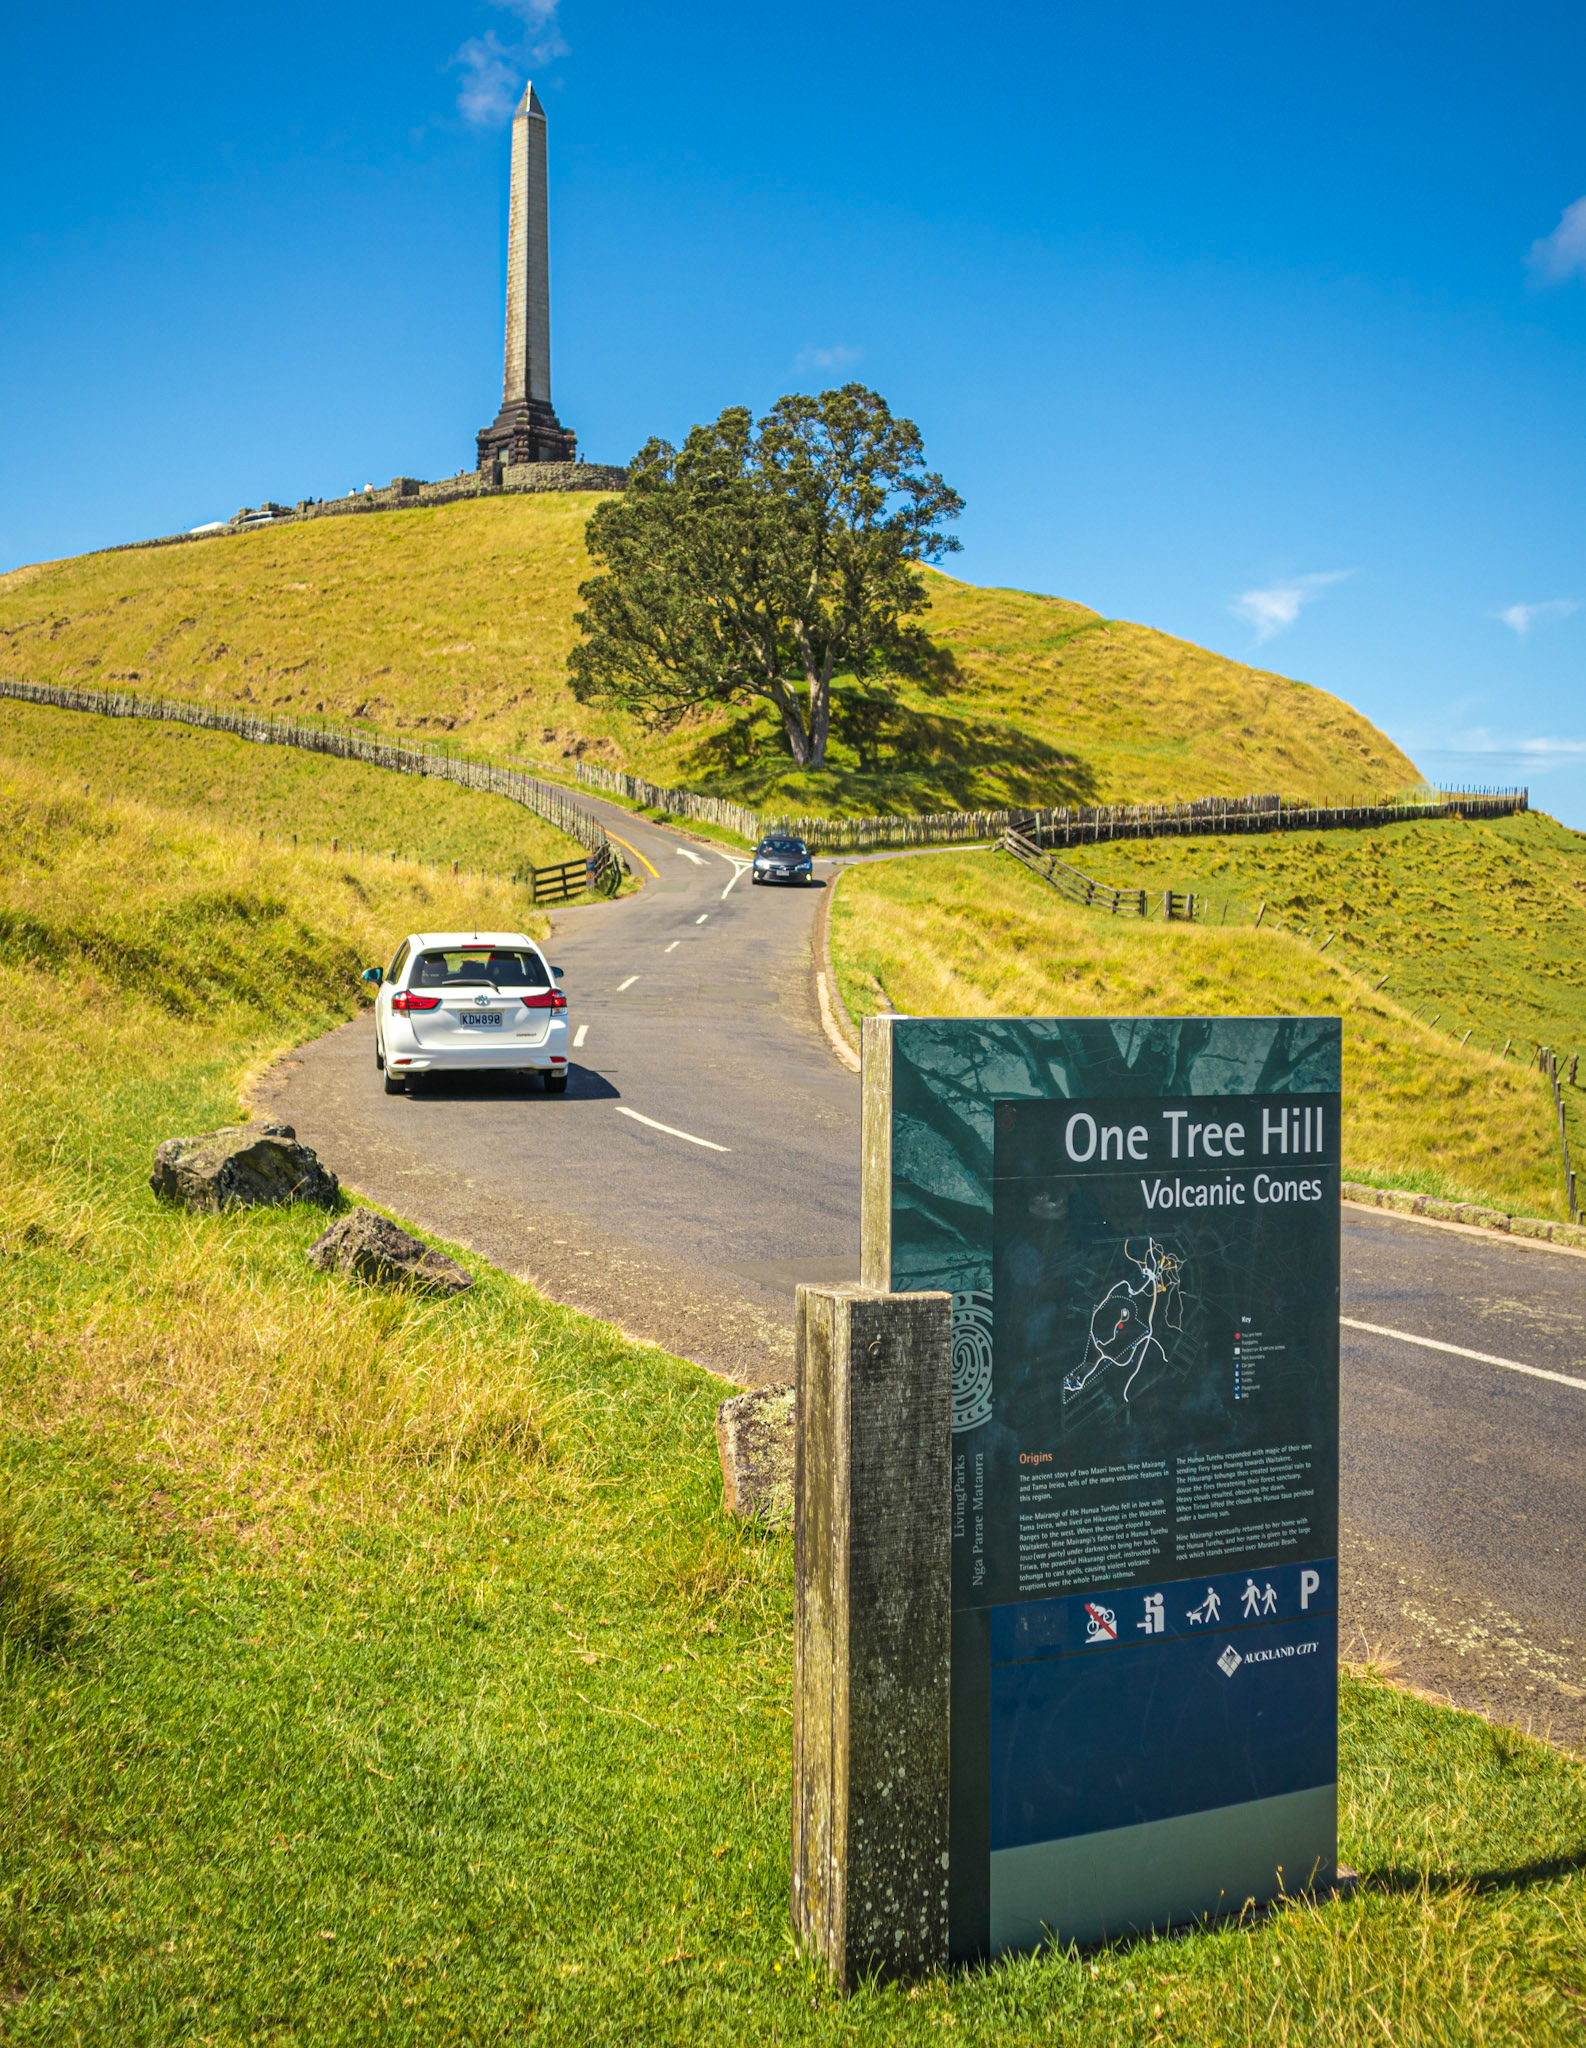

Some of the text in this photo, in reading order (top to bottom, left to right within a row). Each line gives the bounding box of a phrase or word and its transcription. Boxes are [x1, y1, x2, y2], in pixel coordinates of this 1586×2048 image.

[462, 1014, 500, 1024] KDW890
[1066, 1107, 1322, 1161] One Tree Hill
[1141, 1174, 1322, 1209] Volcanic Cones
[1019, 1452, 1053, 1465] Origins
[1142, 1460, 1166, 1469] Mairangi
[1116, 1473, 1138, 1481] volcanic
[955, 1454, 967, 1537] LivingParks
[973, 1453, 985, 1586] Nga Parae Mataora
[1034, 1511, 1060, 1520] Mairangi
[1093, 1514, 1120, 1523] Hikurangi
[1139, 1509, 1166, 1517] Waitakere
[1106, 1523, 1124, 1532] couple
[1126, 1521, 1143, 1530] eloped
[1034, 1553, 1046, 1562] (war
[1048, 1550, 1065, 1560] party)
[1051, 1558, 1076, 1569] powerful
[1078, 1554, 1105, 1564] Hikurangi
[1124, 1549, 1151, 1558] instructed
[1128, 1559, 1150, 1567] volcanic
[1019, 1583, 1046, 1592] eruptions
[1092, 1573, 1111, 1582] Tamaki
[1301, 1570, 1320, 1610] P
[1244, 1642, 1319, 1664] AUCKLAND CITY
